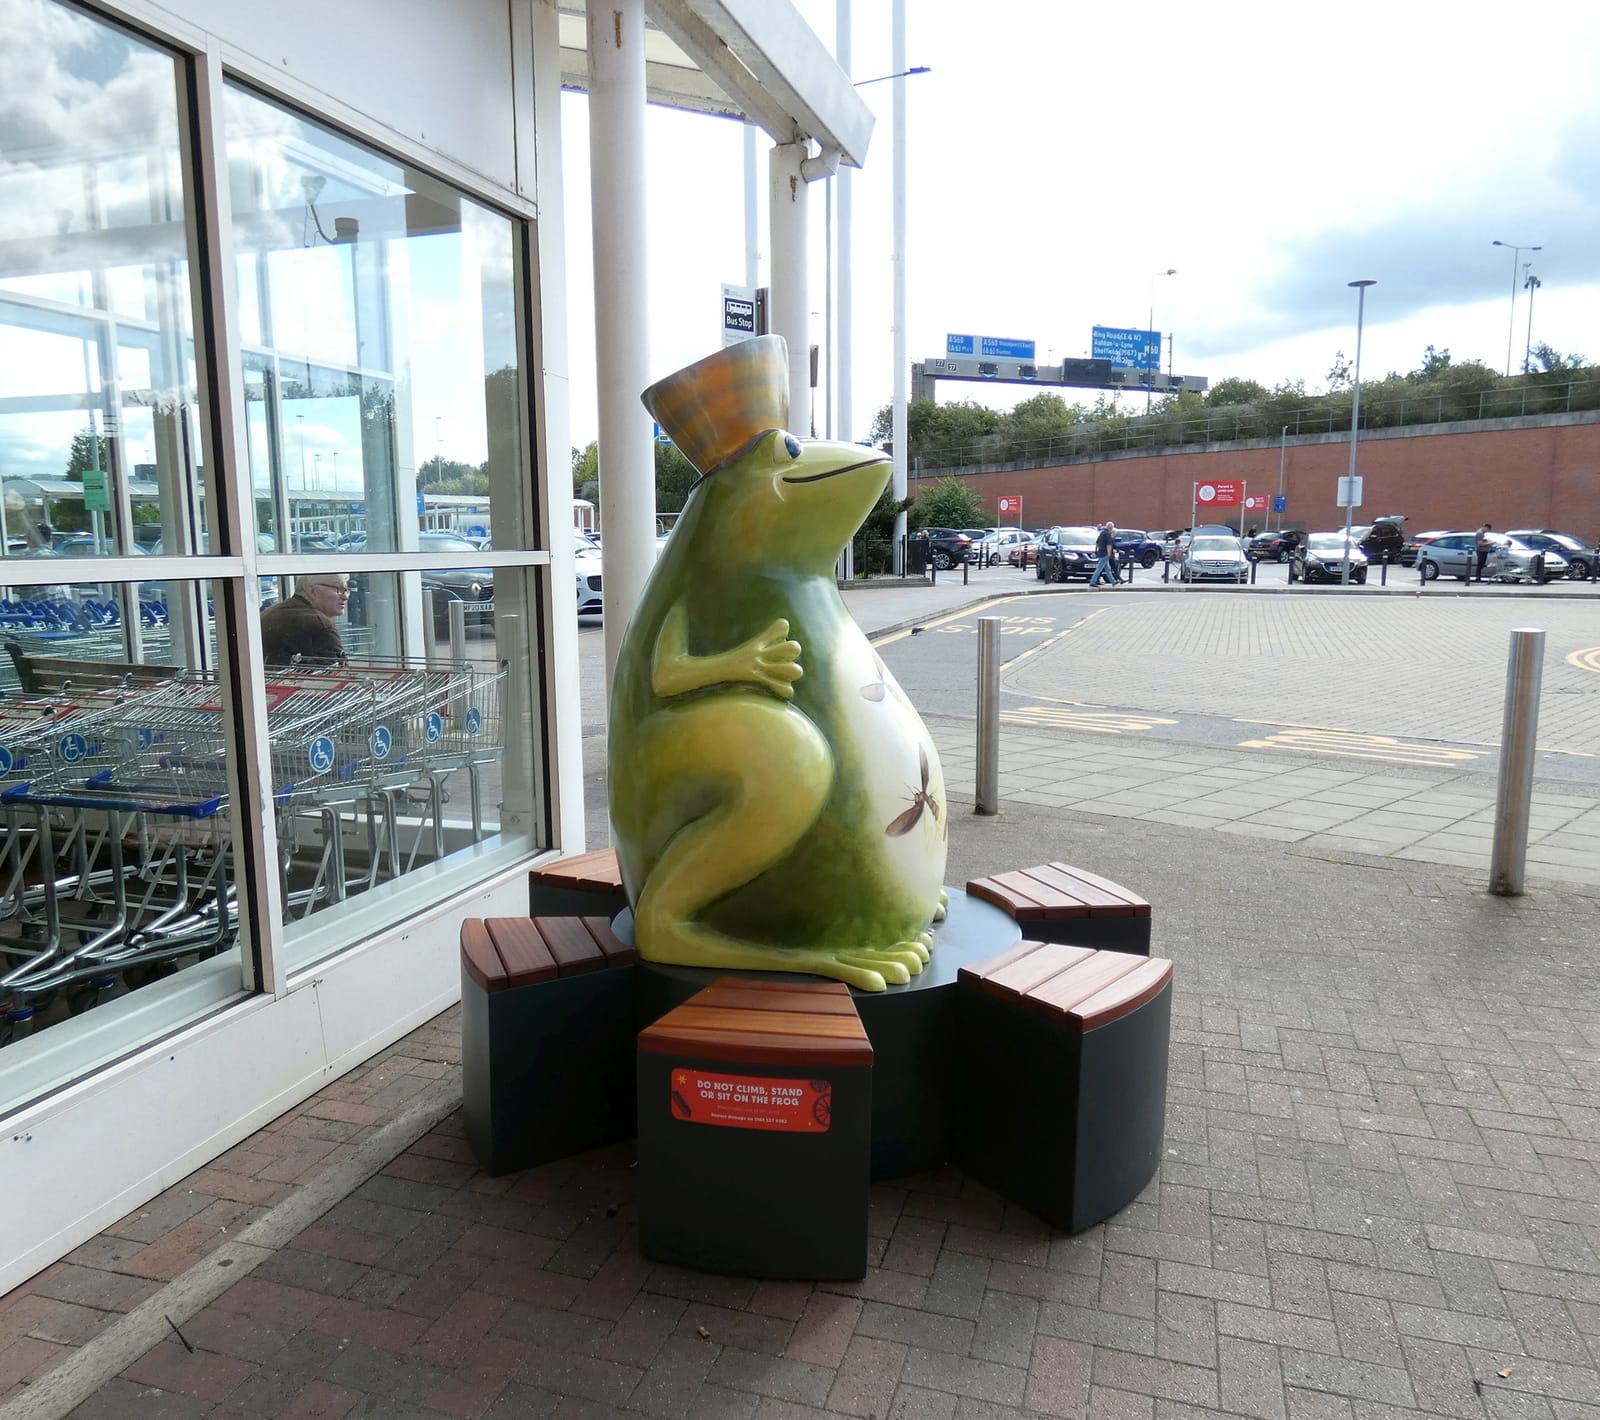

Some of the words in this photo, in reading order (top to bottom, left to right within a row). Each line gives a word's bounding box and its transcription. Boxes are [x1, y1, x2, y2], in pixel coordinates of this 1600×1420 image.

[726, 316, 738, 326] Bus
[738, 317, 752, 329] Stop
[949, 335, 964, 344] A560
[983, 338, 998, 346] A560
[936, 624, 1053, 635] SOP
[697, 1079, 711, 1089] DO
[713, 1082, 734, 1092] NOT
[736, 1084, 768, 1096] CLIMB,
[771, 1087, 803, 1097] STAND
[700, 1090, 714, 1099] OR
[717, 1091, 731, 1101] SIT
[733, 1093, 749, 1103] ON
[751, 1095, 769, 1104] THE
[771, 1096, 800, 1106] FROG
